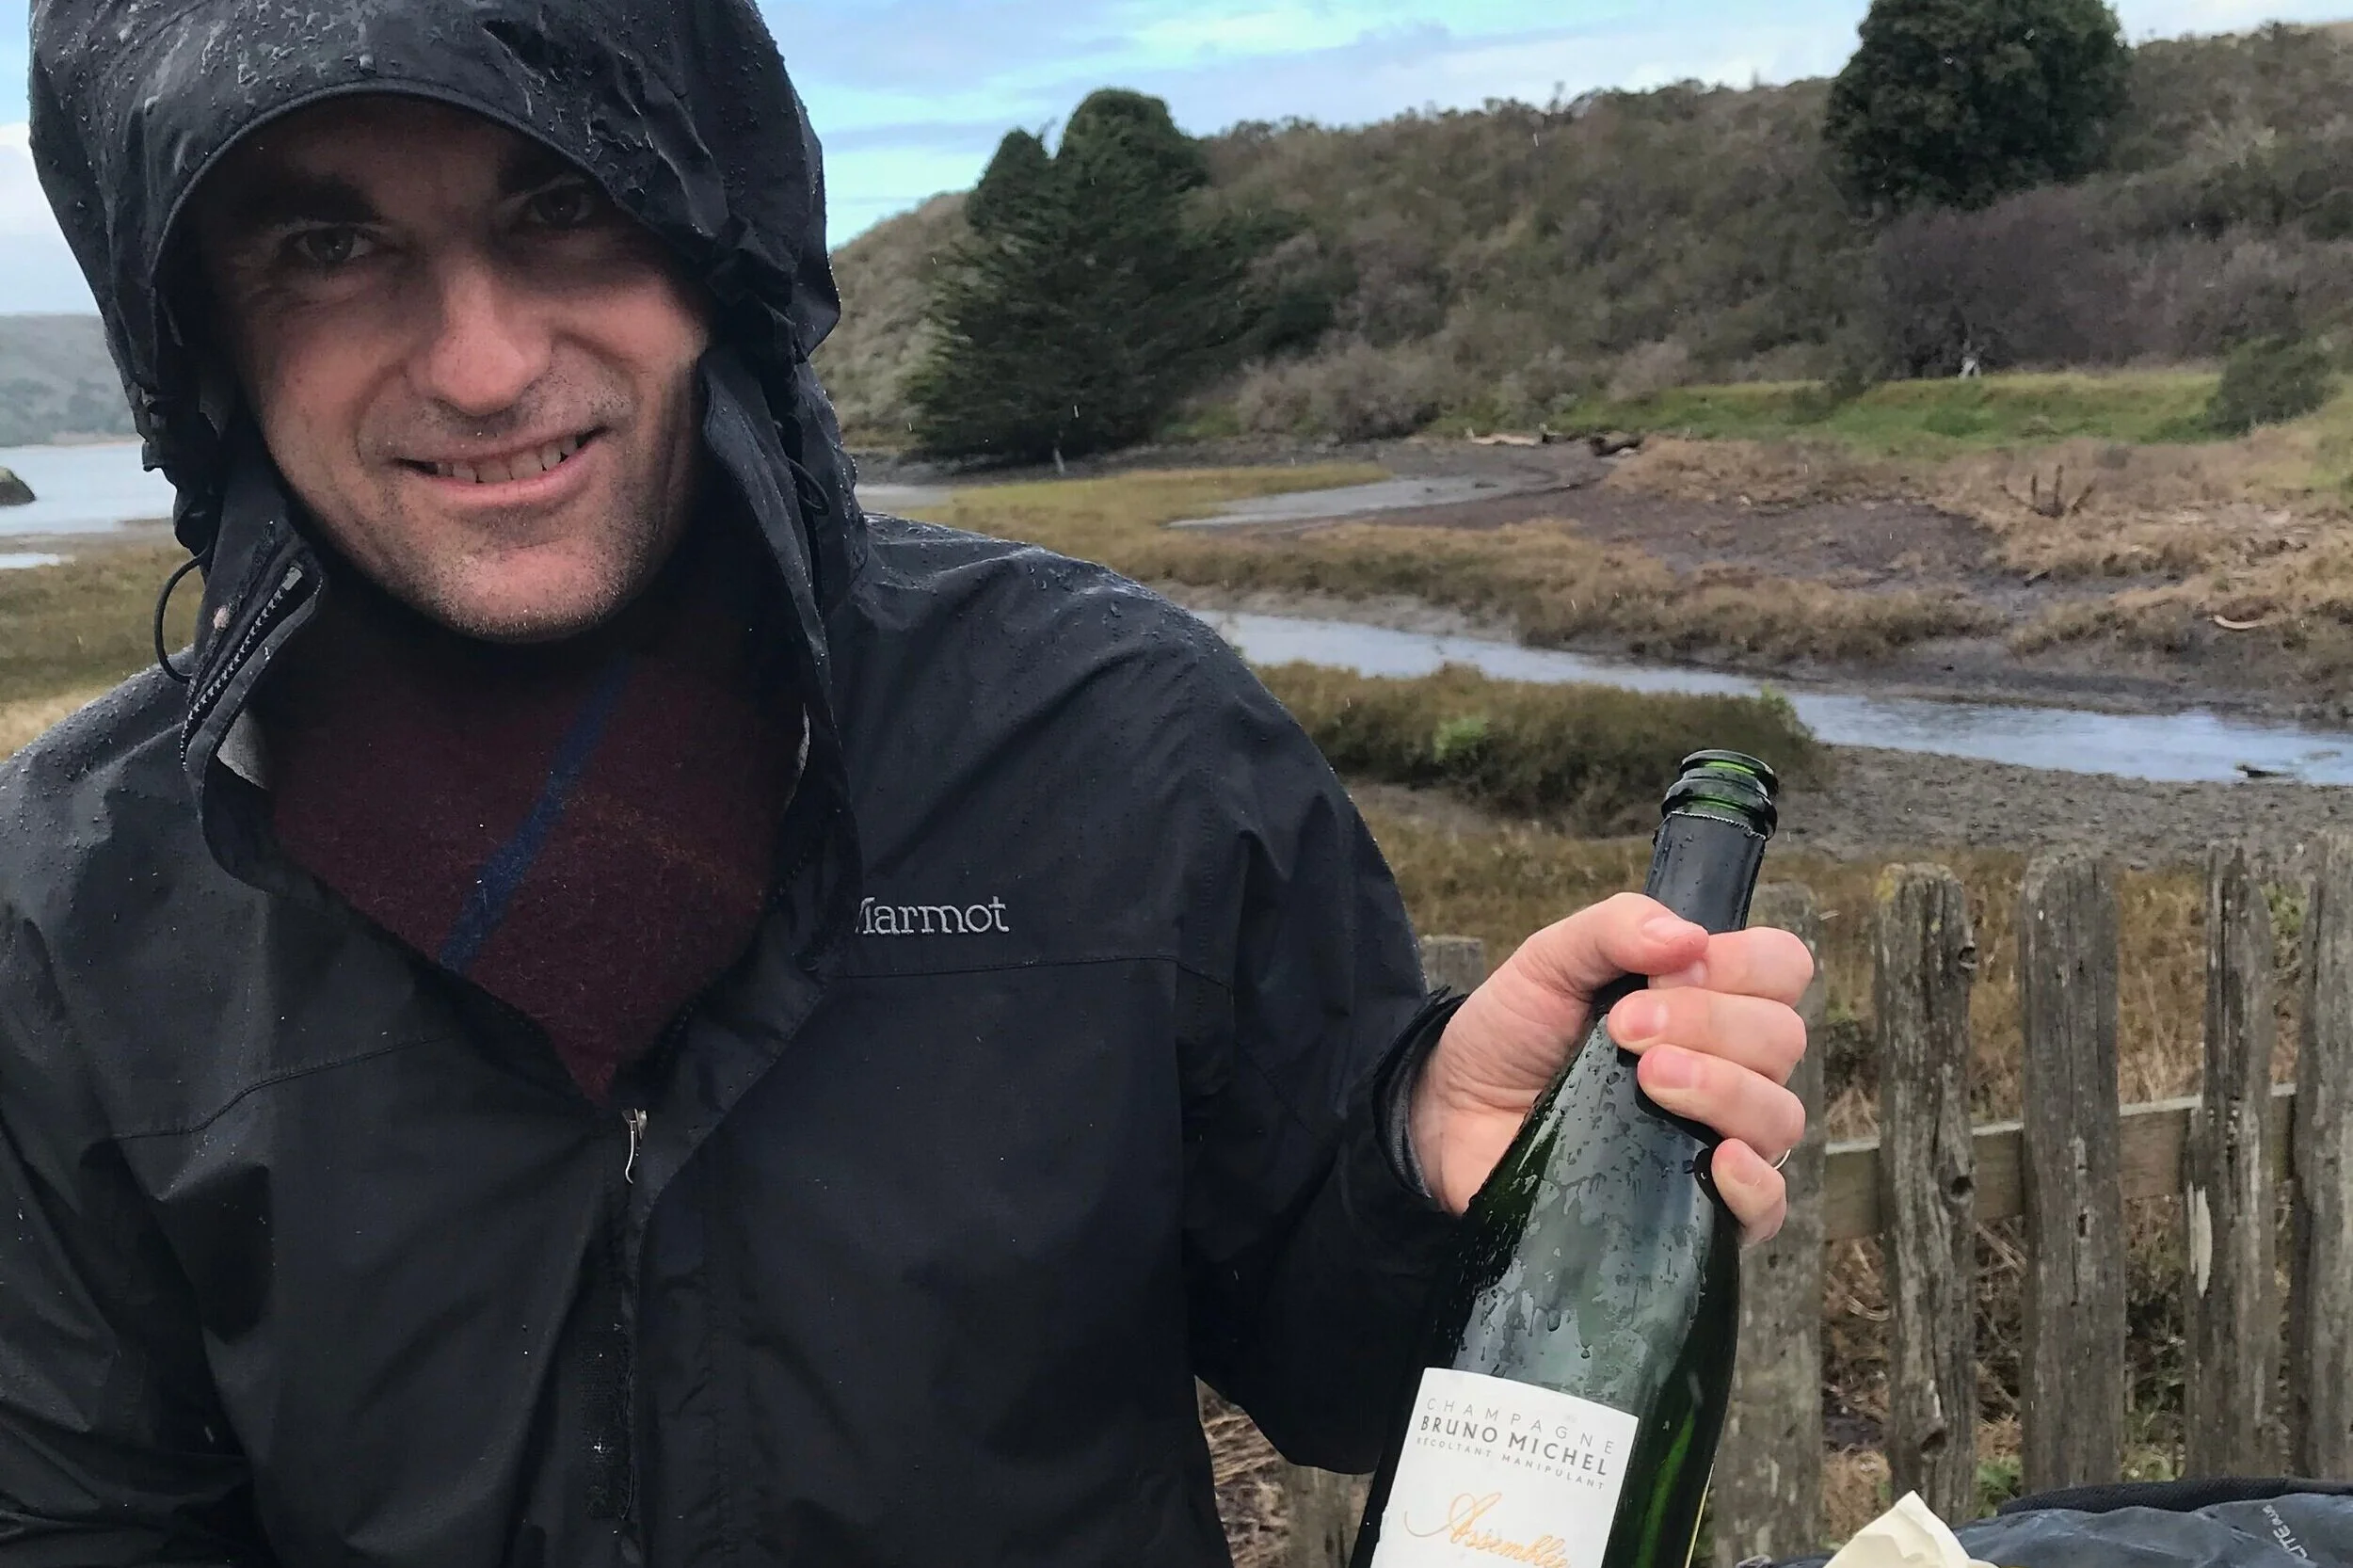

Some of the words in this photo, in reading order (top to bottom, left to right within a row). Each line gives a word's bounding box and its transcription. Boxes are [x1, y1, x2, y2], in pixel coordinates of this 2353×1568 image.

[1420, 1416, 1497, 1443] BRUNO
[1508, 1432, 1607, 1476] MICHEL
[1427, 1398, 1614, 1455] CHAMPAGNE
[1502, 1453, 1605, 1490] MANIPULANT
